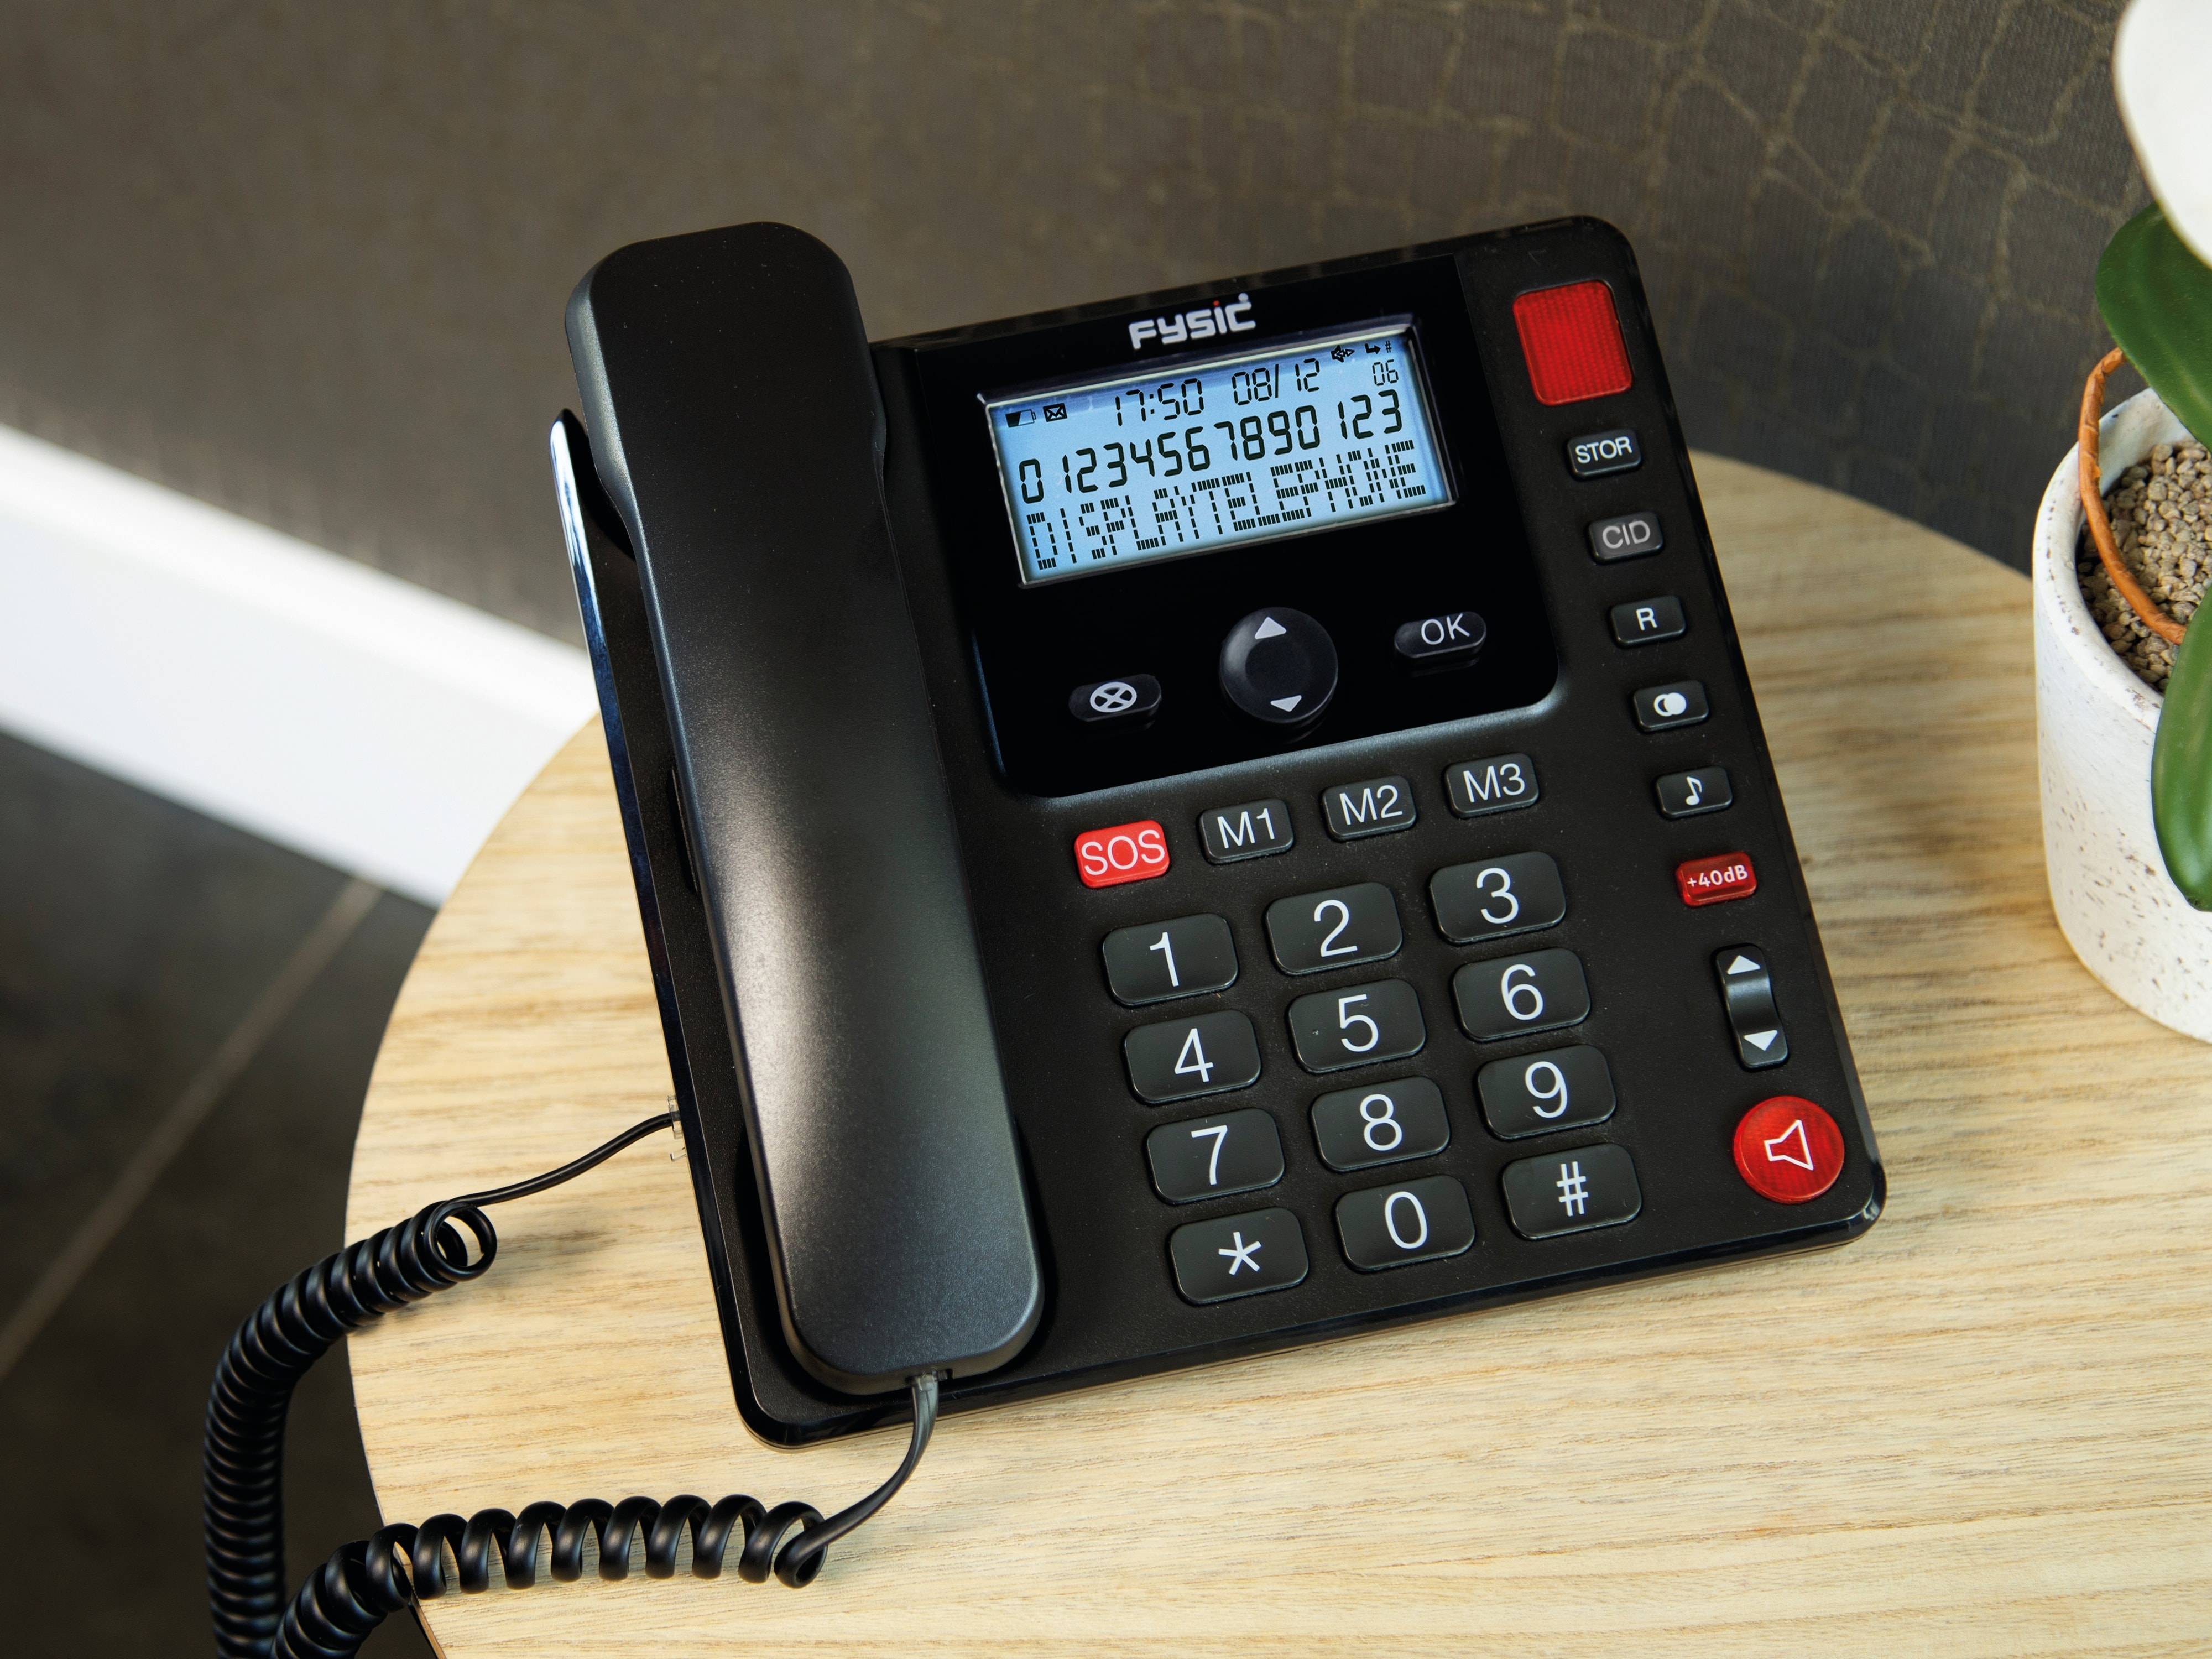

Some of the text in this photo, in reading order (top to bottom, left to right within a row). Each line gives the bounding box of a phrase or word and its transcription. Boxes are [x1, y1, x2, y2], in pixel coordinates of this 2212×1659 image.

[1113, 358, 1399, 426] 17:50 08/12 06
[1575, 436, 1633, 464] STOR
[1026, 439, 1426, 570] DISPLAYTELEPHONE
[1601, 520, 1651, 549] CID
[1420, 613, 1470, 645] OK
[1635, 607, 1658, 631] R
[1339, 784, 1404, 826] M2
[1463, 763, 1526, 803] M3
[1081, 828, 1166, 876] SOS
[1217, 808, 1275, 849] M1
[1475, 867, 1519, 924] 3
[1687, 864, 1749, 888] +40dB
[1313, 899, 1358, 958] 2
[1149, 931, 1180, 987] 1
[1500, 963, 1544, 1021] 6
[1338, 993, 1379, 1052] 5
[1173, 1027, 1214, 1083] 4
[1524, 1060, 1568, 1119] 9
[1359, 1093, 1403, 1151] 8
[1190, 1124, 1228, 1186] 7
[1384, 1191, 1428, 1250] 0
